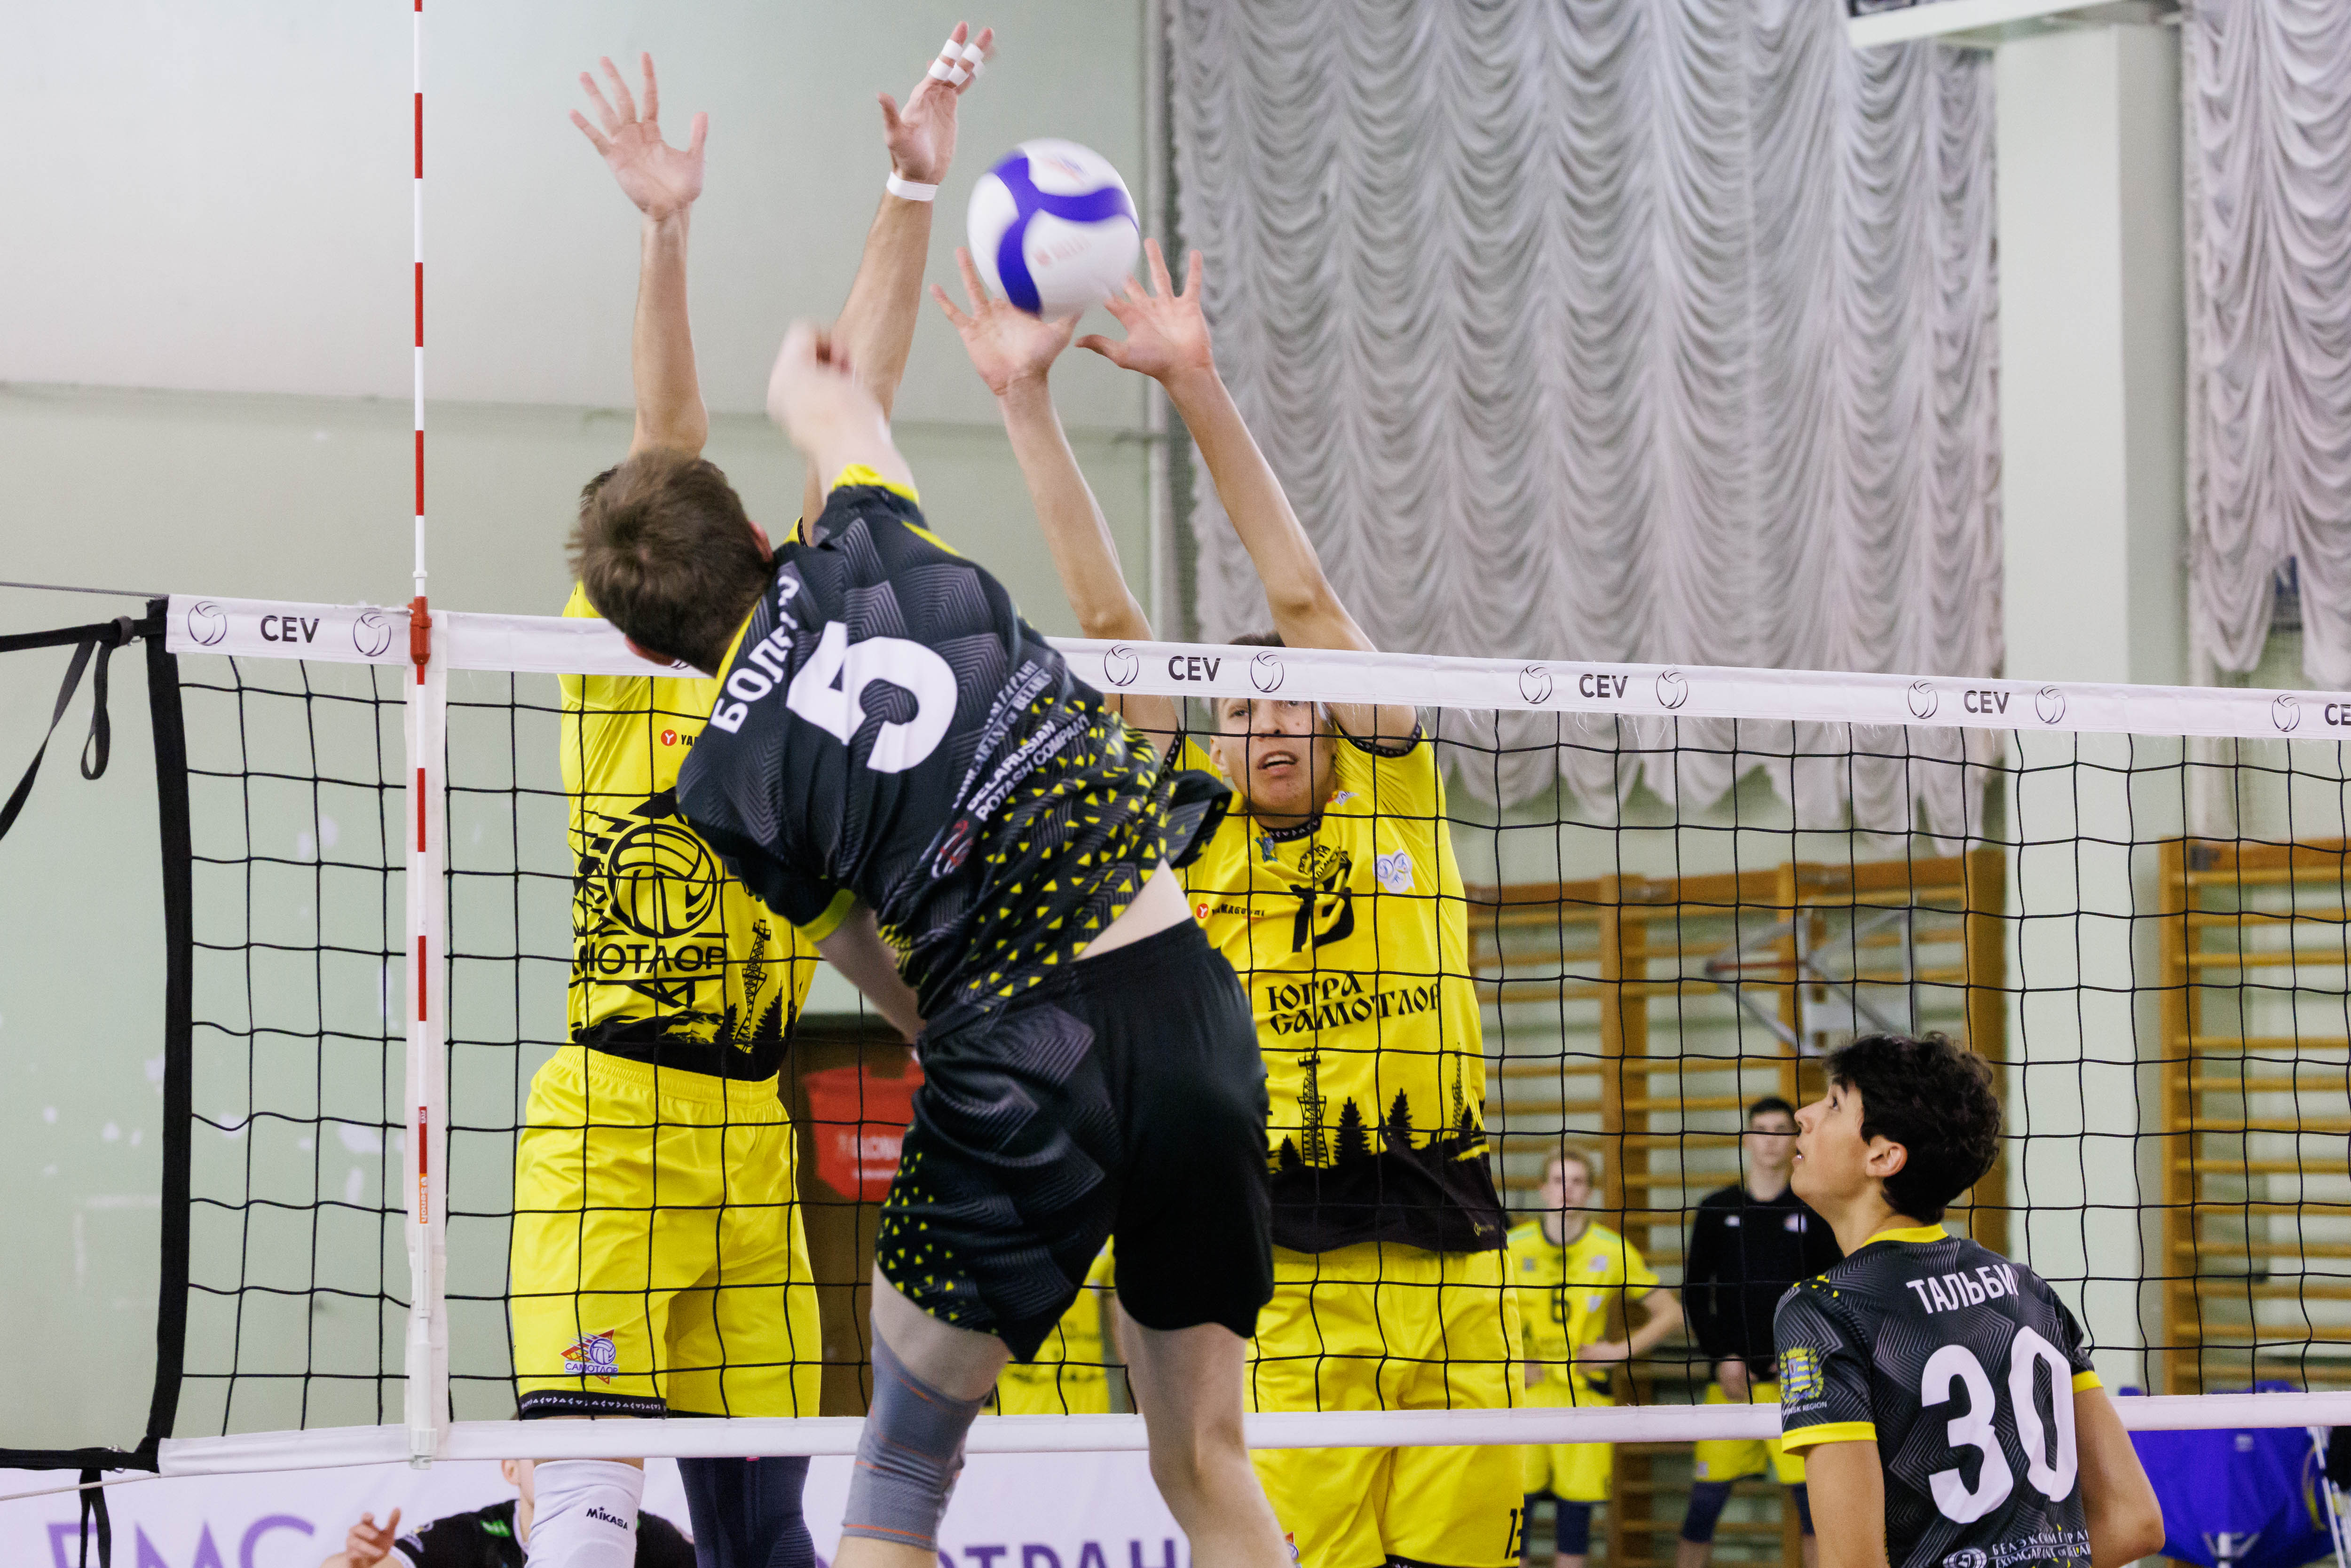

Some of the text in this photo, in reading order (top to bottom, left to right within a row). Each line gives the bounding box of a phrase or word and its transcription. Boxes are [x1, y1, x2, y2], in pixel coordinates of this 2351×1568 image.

[260, 615, 320, 644] CEV
[1168, 656, 1222, 682] CEV
[786, 621, 958, 773] 5
[1579, 674, 1629, 699] CEV
[1964, 690, 2011, 714] CEV
[2325, 704, 2351, 726] CE
[1265, 969, 1364, 1012] ЮГРА
[1906, 1263, 2019, 1314] ТАЛЬБИ
[1803, 1400, 1827, 1412] REGION
[1921, 1325, 2078, 1524] 30
